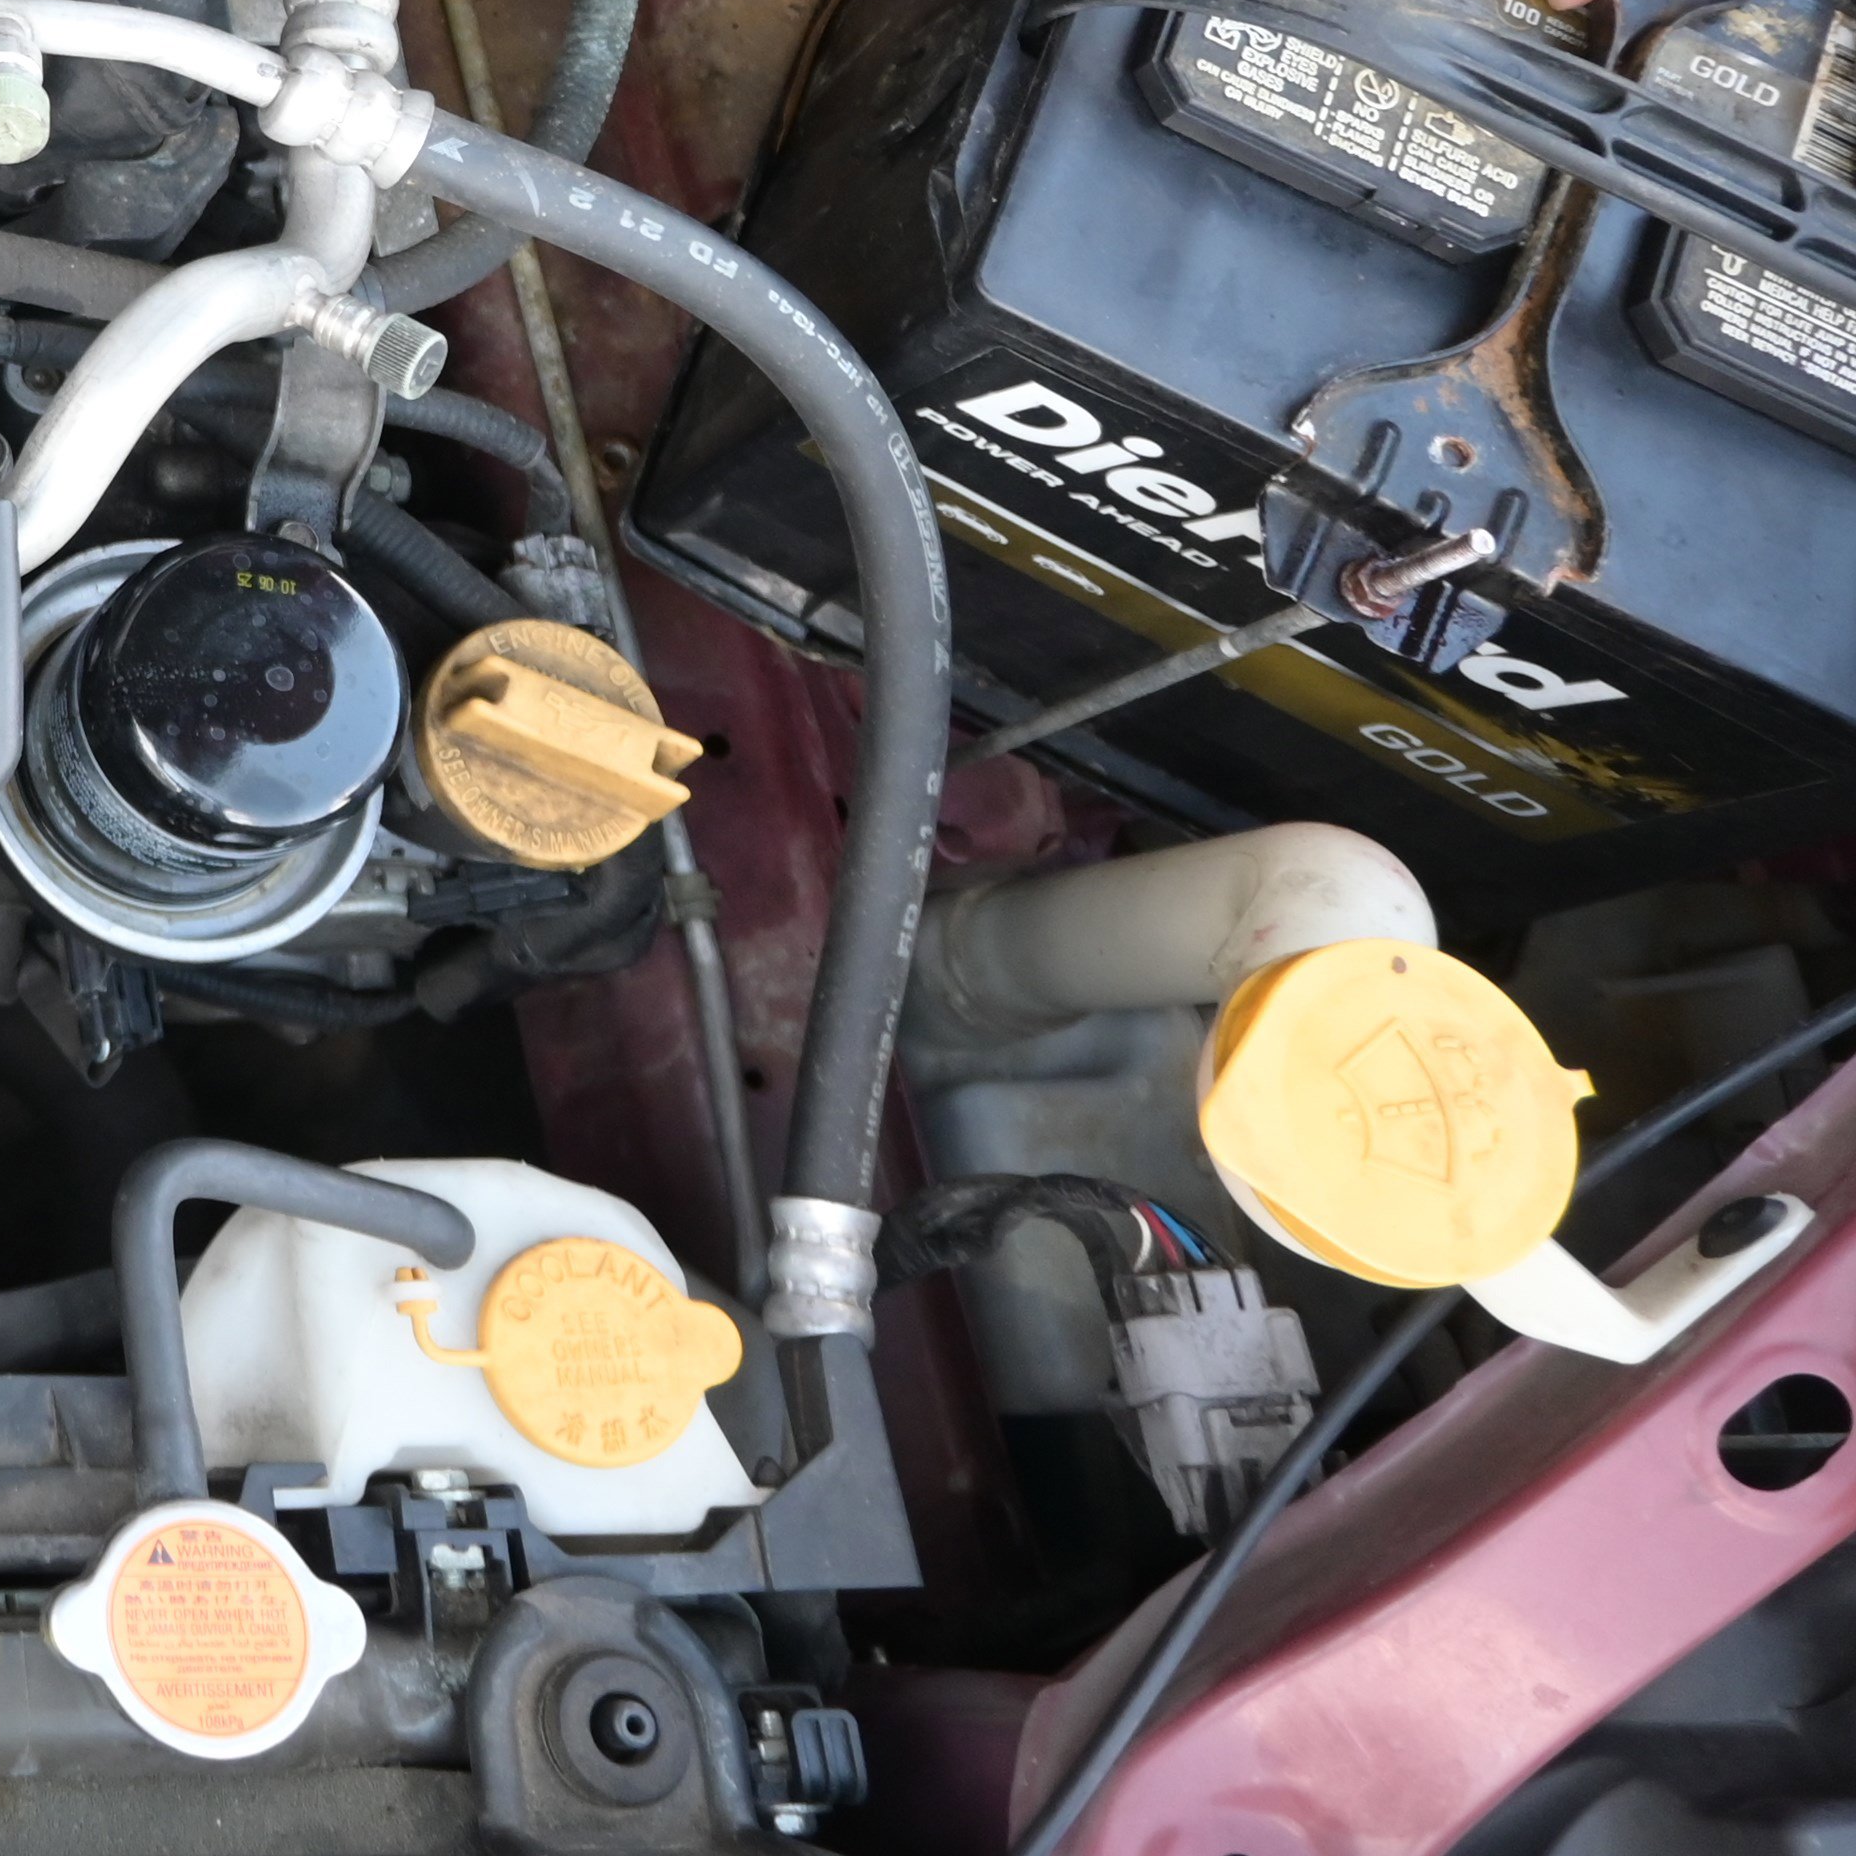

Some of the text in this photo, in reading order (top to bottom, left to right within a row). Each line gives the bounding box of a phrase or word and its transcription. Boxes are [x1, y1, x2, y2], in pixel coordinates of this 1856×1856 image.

[1196, 58, 1220, 77] CAN
[1241, 46, 1319, 93] EXPLOSIVE
[1280, 49, 1319, 75] EYES
[1285, 36, 1338, 69] SHIELD
[1237, 61, 1284, 93] GASES
[1689, 55, 1781, 107] GOLD
[1352, 101, 1380, 123] NO
[1407, 143, 1478, 184] CAN CAUSE
[1411, 128, 1519, 190] SULFURIC ACID
[568, 186, 597, 210] 2
[1474, 185, 1496, 206] OR
[618, 209, 666, 243] 21
[688, 240, 739, 280] FD
[1707, 289, 1754, 319] FOLLOW
[1759, 278, 1809, 313] MEDICAL
[1812, 304, 1847, 327] HELP
[1759, 300, 1783, 319] FOR
[1784, 312, 1814, 335] SAFE
[768, 288, 864, 388] HFC-134a
[914, 406, 1220, 570] POWER AHEAD
[955, 380, 1630, 711] Died
[489, 626, 603, 667] ENGINE
[1358, 720, 1549, 820] GOLD
[439, 747, 628, 854] SEE OWNER'S MANUAL
[500, 1249, 674, 1321] COOLANT
[561, 1311, 609, 1335] SEE
[556, 1360, 655, 1387] MANUAL
[176, 1545, 255, 1559] WARNING
[125, 1608, 288, 1621] NEVER OPEN WHEN HOT
[156, 1682, 275, 1699] AVERTISSEMENT
